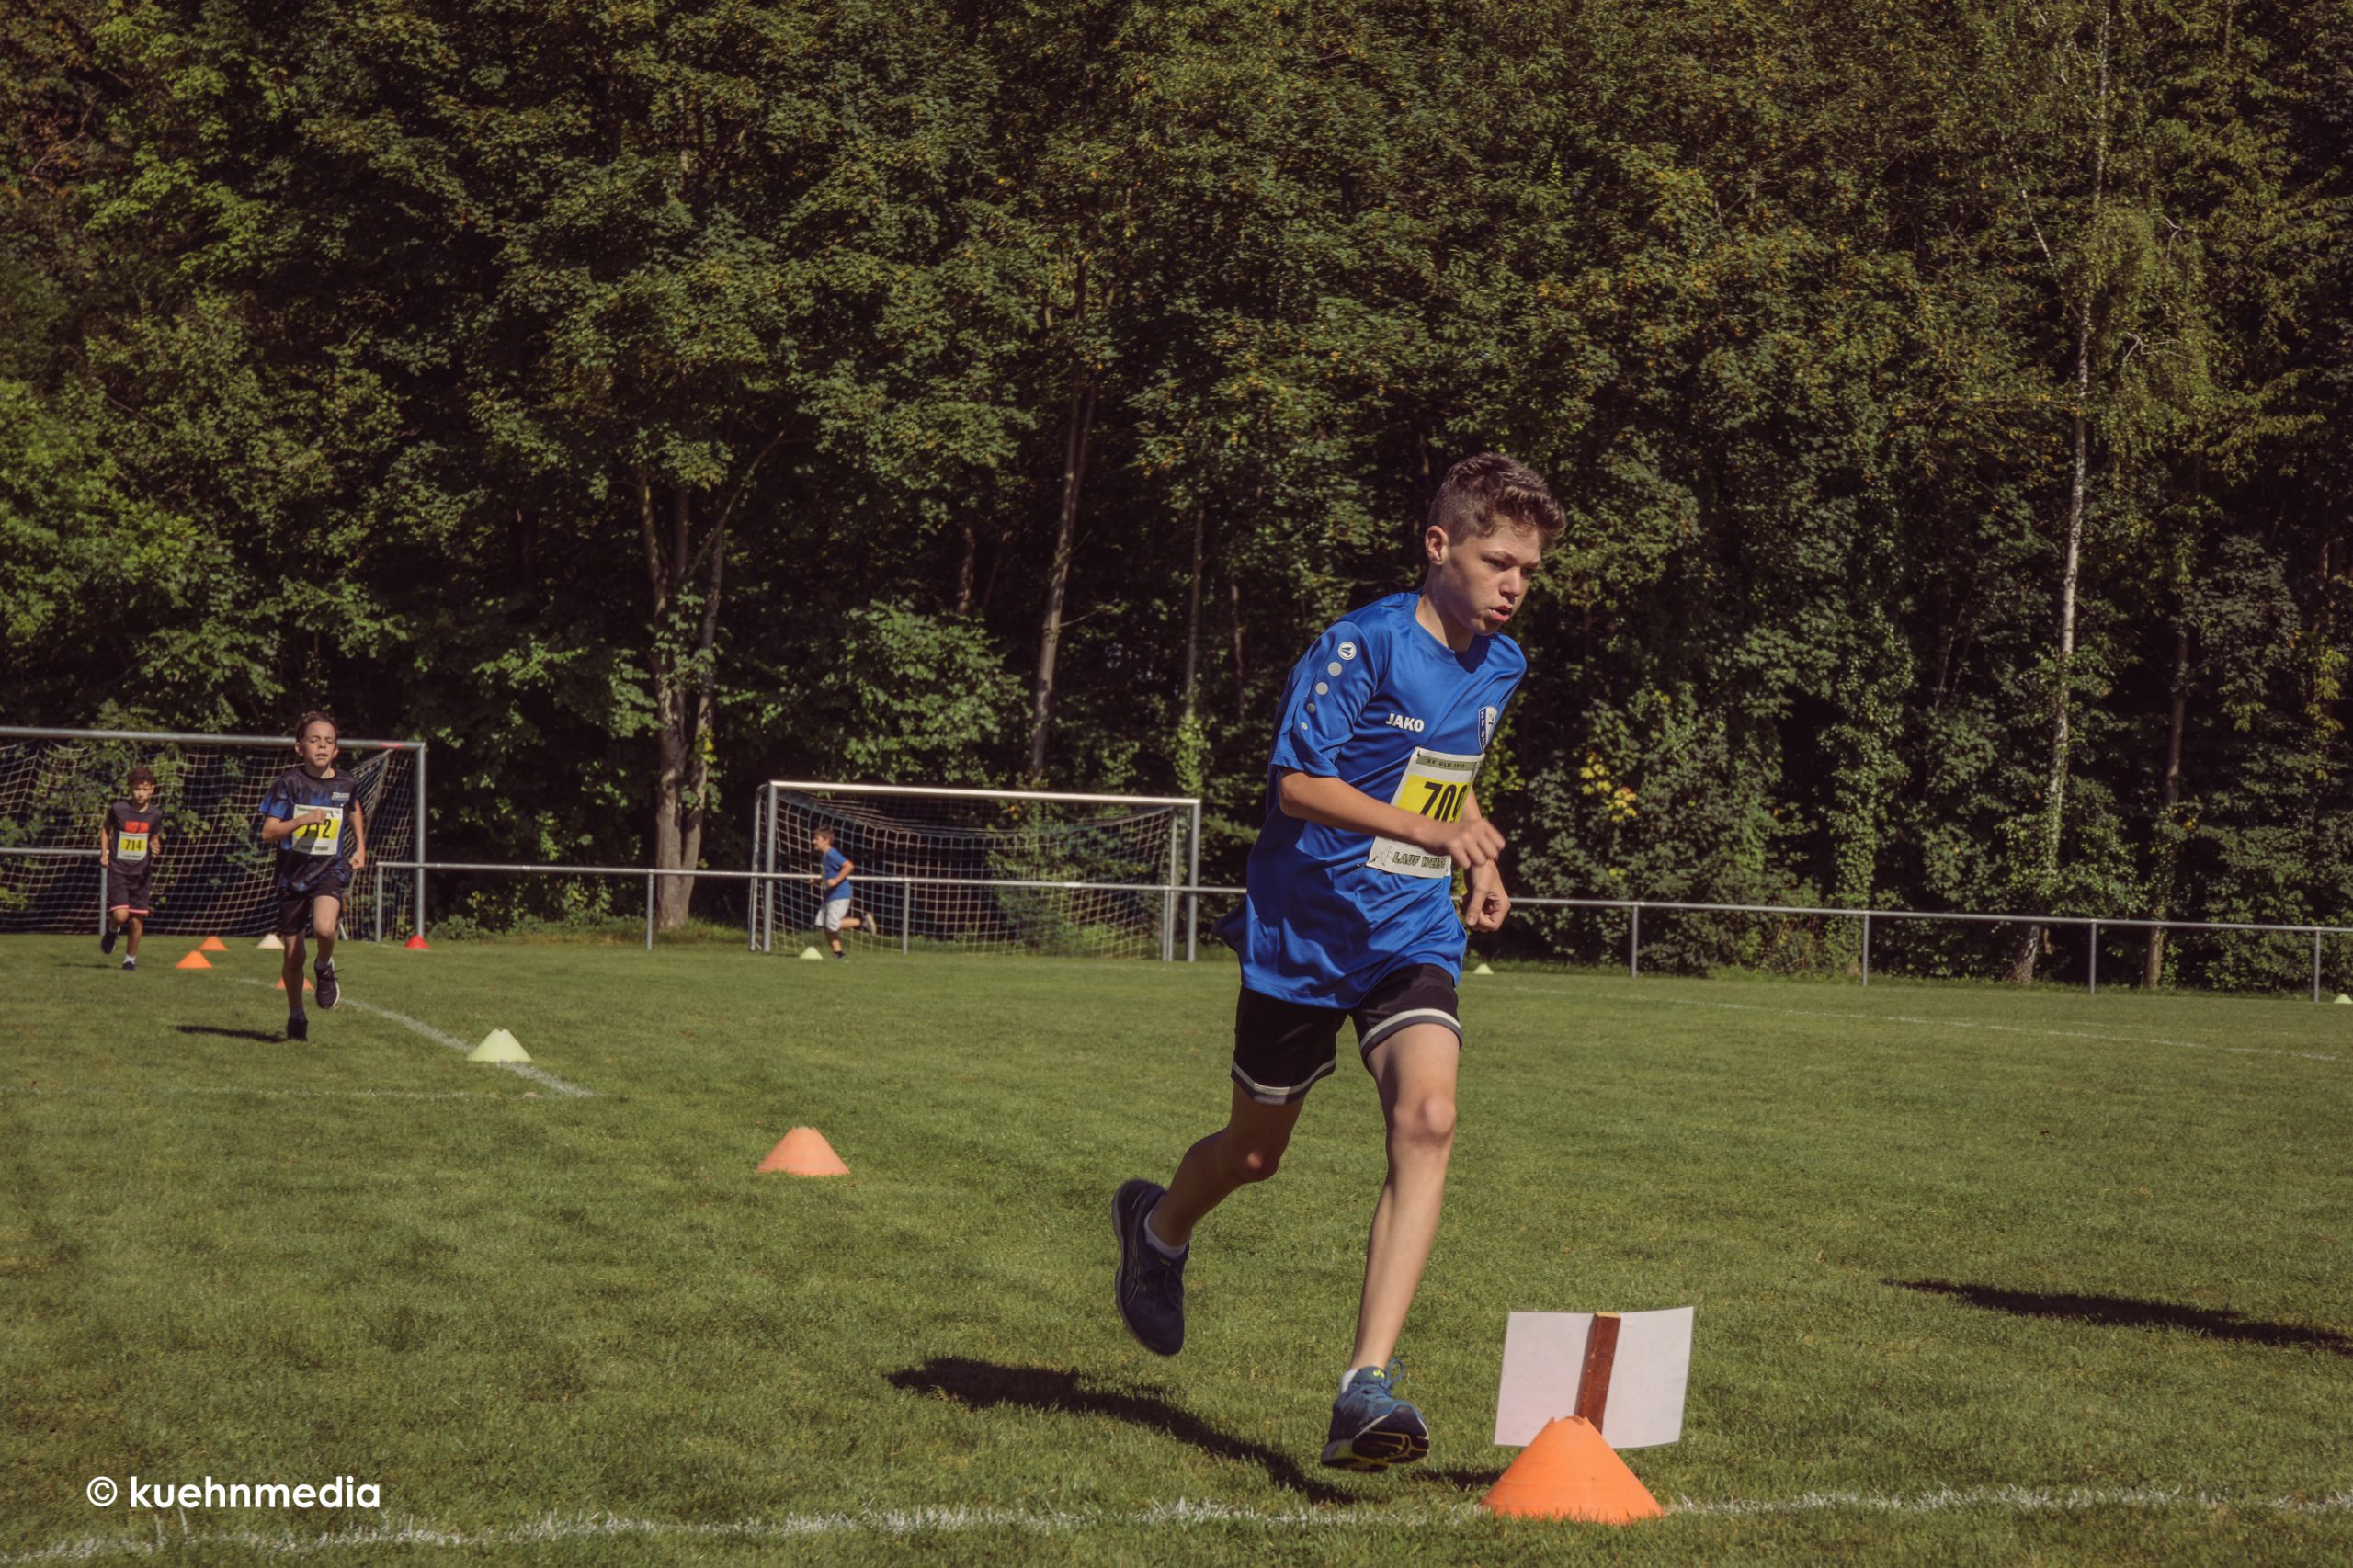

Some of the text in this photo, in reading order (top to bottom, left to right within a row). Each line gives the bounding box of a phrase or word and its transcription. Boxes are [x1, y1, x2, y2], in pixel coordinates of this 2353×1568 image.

[1385, 712, 1425, 733] JAKO
[125, 838, 142, 851] 714
[1392, 851, 1421, 867] LAUF
